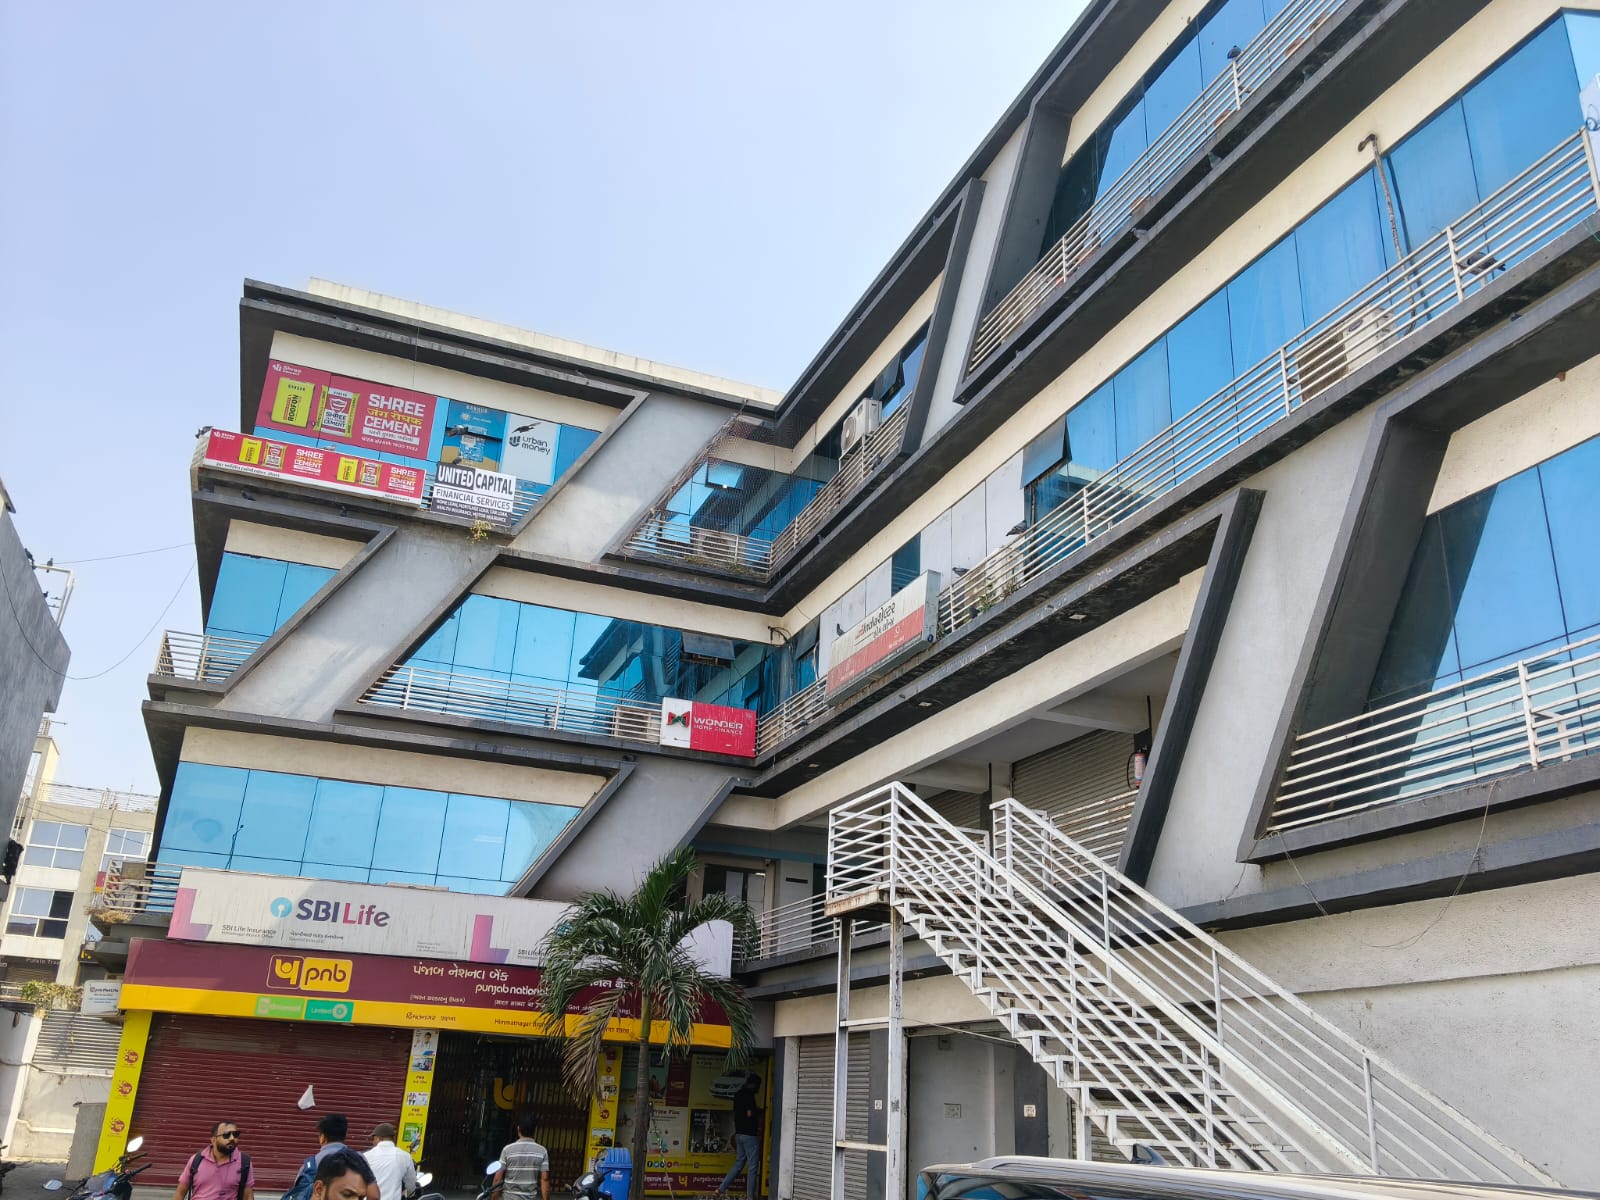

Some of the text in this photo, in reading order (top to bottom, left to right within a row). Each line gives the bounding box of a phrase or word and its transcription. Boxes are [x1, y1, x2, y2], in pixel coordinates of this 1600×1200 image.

[368, 393, 426, 417] SHREE
[326, 411, 347, 420] SHREE
[364, 415, 422, 436] CEMENT
[522, 436, 548, 447] urban
[296, 448, 324, 460] SHREE
[521, 443, 551, 455] money
[294, 459, 322, 469] CEMENT
[391, 466, 417, 477] SHREE
[438, 465, 513, 495] UNITED CAPITAL
[436, 488, 510, 510] FINANCIAL SERVICES
[693, 717, 744, 730] WONDER
[715, 727, 743, 735] FINANCE
[296, 898, 390, 927] SBI Life
[304, 963, 347, 986] pnb
[413, 962, 444, 977] પંજાબ
[448, 963, 486, 980] નેશનલ
[475, 984, 509, 994] punjab
